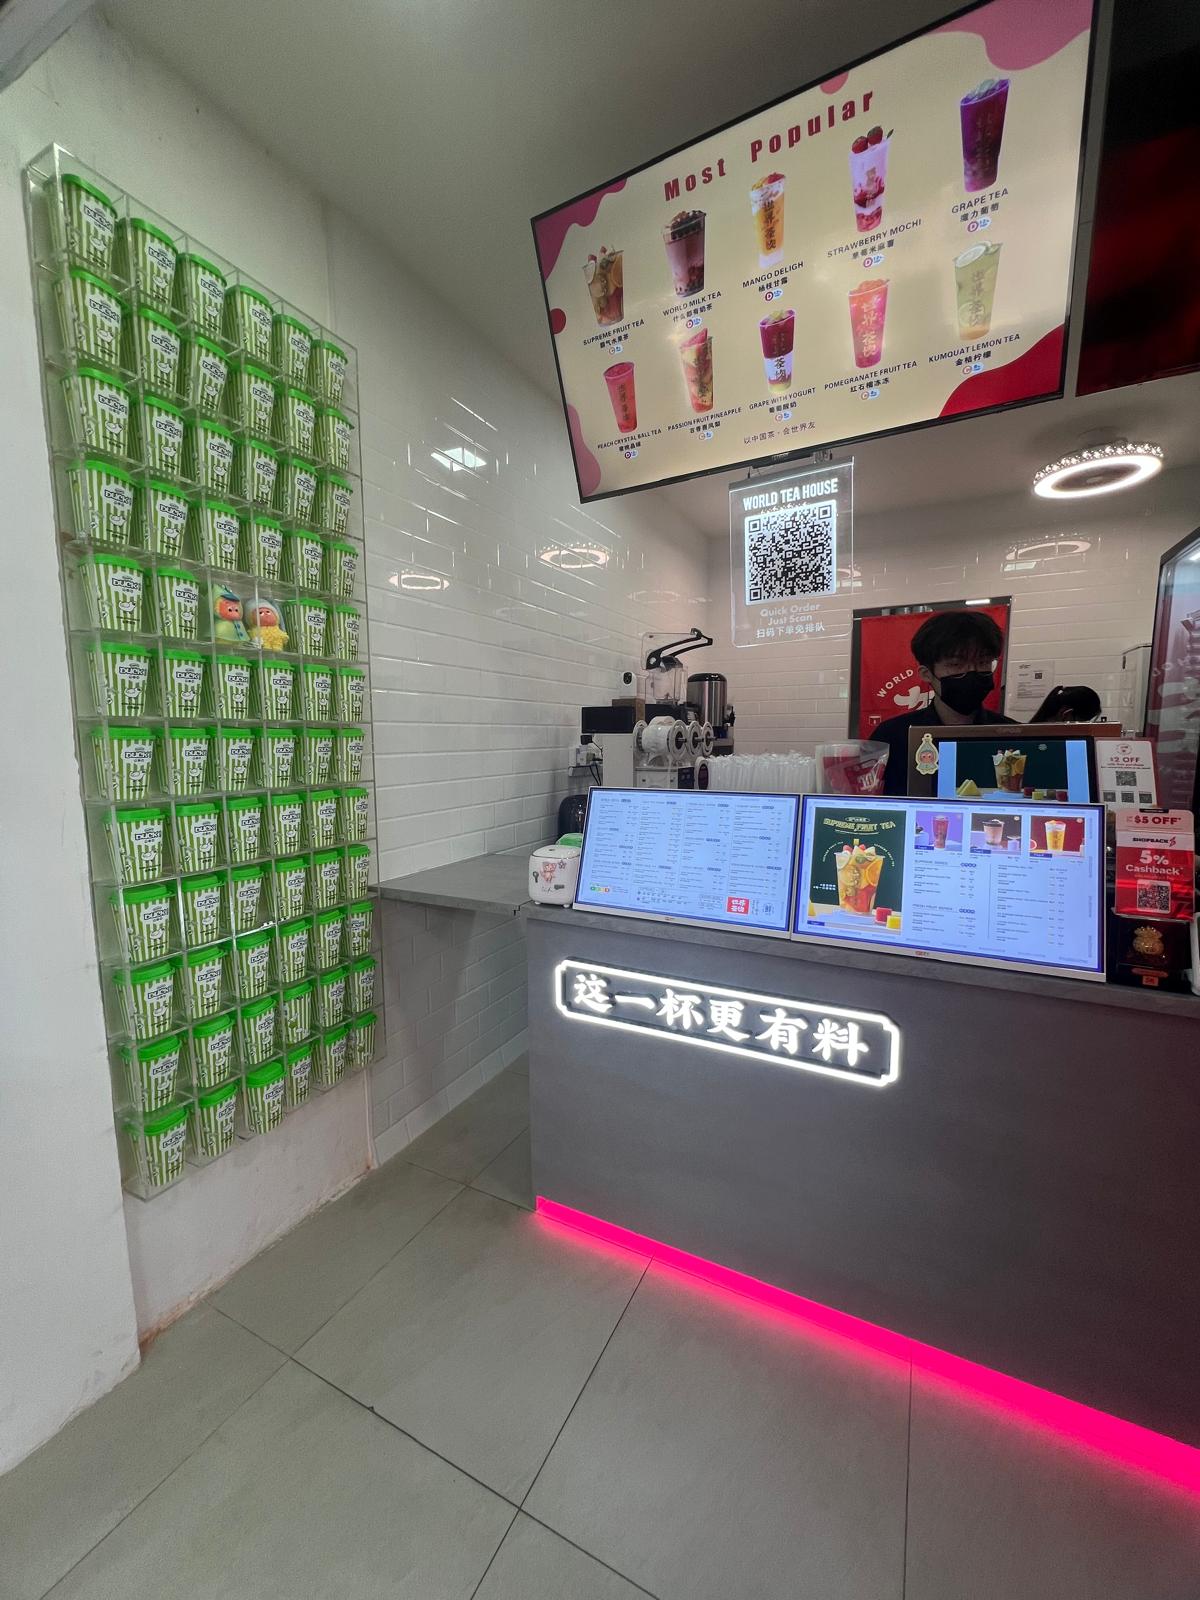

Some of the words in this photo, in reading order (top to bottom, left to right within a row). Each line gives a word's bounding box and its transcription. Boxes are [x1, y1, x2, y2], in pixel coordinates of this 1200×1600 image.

[664, 158, 726, 201] Most
[750, 90, 873, 163] Popular
[952, 195, 986, 214] GRAPE
[989, 188, 1009, 201] TEA
[827, 231, 888, 258] STRAWBERRY
[889, 218, 922, 236] MOCHI
[742, 272, 773, 288] MANGO
[774, 261, 804, 277] DELIGH
[662, 303, 688, 316] WORLD
[688, 297, 707, 307] MILK
[707, 290, 722, 301] TEA
[583, 331, 612, 346] SUPREME
[612, 324, 631, 335] FRUIT
[632, 318, 645, 328] TEA
[928, 345, 970, 363] KUMQUAT
[971, 338, 1002, 352] LEMON
[1003, 333, 1020, 344] TEA
[824, 372, 878, 390] POMEGRANATE
[879, 365, 901, 377] FRUIT
[902, 360, 918, 371] TEA
[749, 400, 769, 410] GRAPE
[771, 395, 788, 404] WITH
[788, 387, 816, 399] YOGURT
[667, 421, 693, 431] PASSION
[692, 415, 709, 425] FRUIT
[710, 406, 742, 420] PINEAPPLE
[597, 440, 614, 449] PEACH
[614, 435, 637, 445] CRYSTAL
[637, 431, 651, 439] BALL
[651, 428, 662, 436] TEA
[743, 491, 778, 511] WORLD
[780, 487, 801, 504] TEA
[802, 478, 839, 499] HOUSE
[760, 606, 787, 617] Quick
[790, 603, 820, 613] Order
[768, 615, 787, 626] Just
[789, 613, 813, 623] Scan
[877, 669, 914, 698] WORLD
[879, 820, 896, 830] TEA
[1134, 815, 1149, 824] $5
[1139, 849, 1169, 865] 5%
[573, 972, 870, 1066] 这一杯更有料
